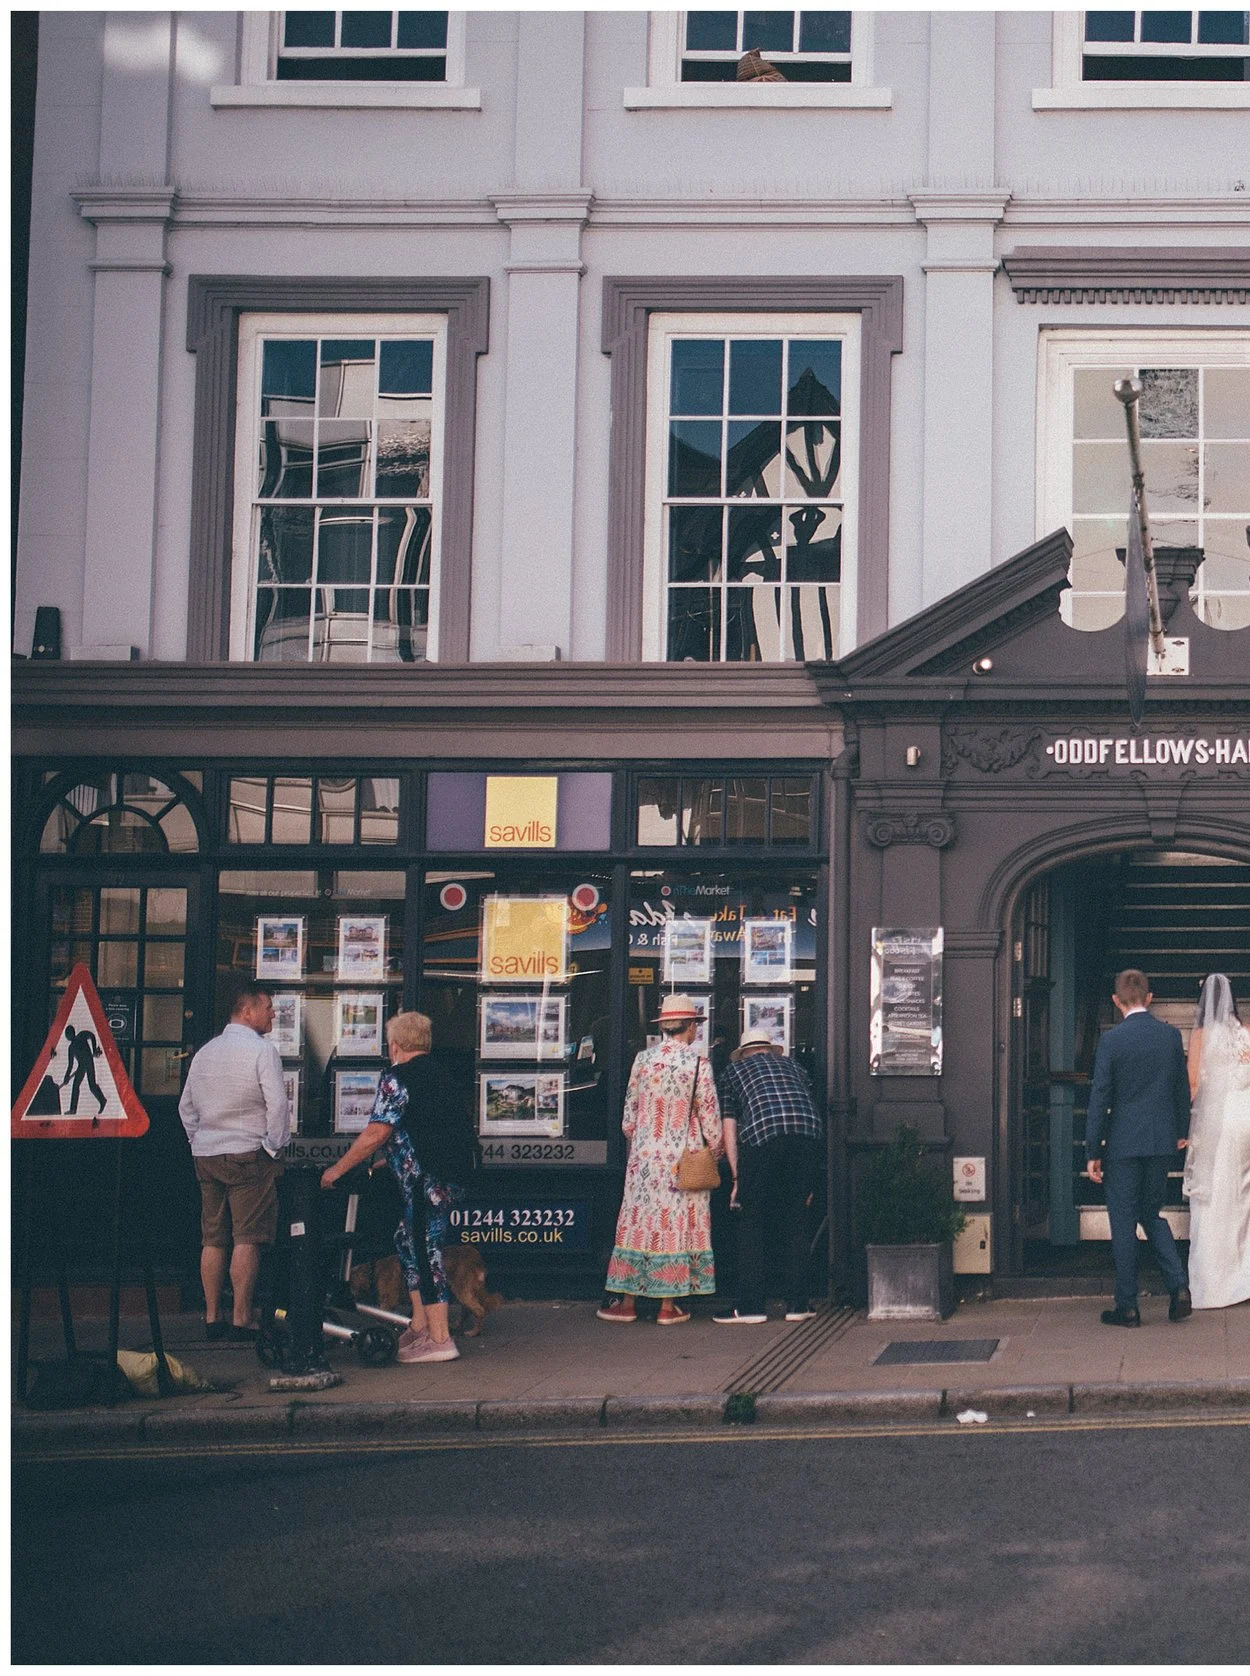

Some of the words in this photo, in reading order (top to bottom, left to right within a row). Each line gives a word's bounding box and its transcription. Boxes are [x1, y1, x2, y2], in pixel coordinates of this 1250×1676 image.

[1054, 739, 1208, 764] ODDFELLOWS
[490, 820, 552, 842] savills
[490, 951, 559, 974] savills
[480, 1143, 505, 1159] 44
[511, 1144, 575, 1160] 323232
[449, 1209, 504, 1226] 01244
[510, 1209, 575, 1226] 323232
[460, 1228, 563, 1243] savills.co.uk
